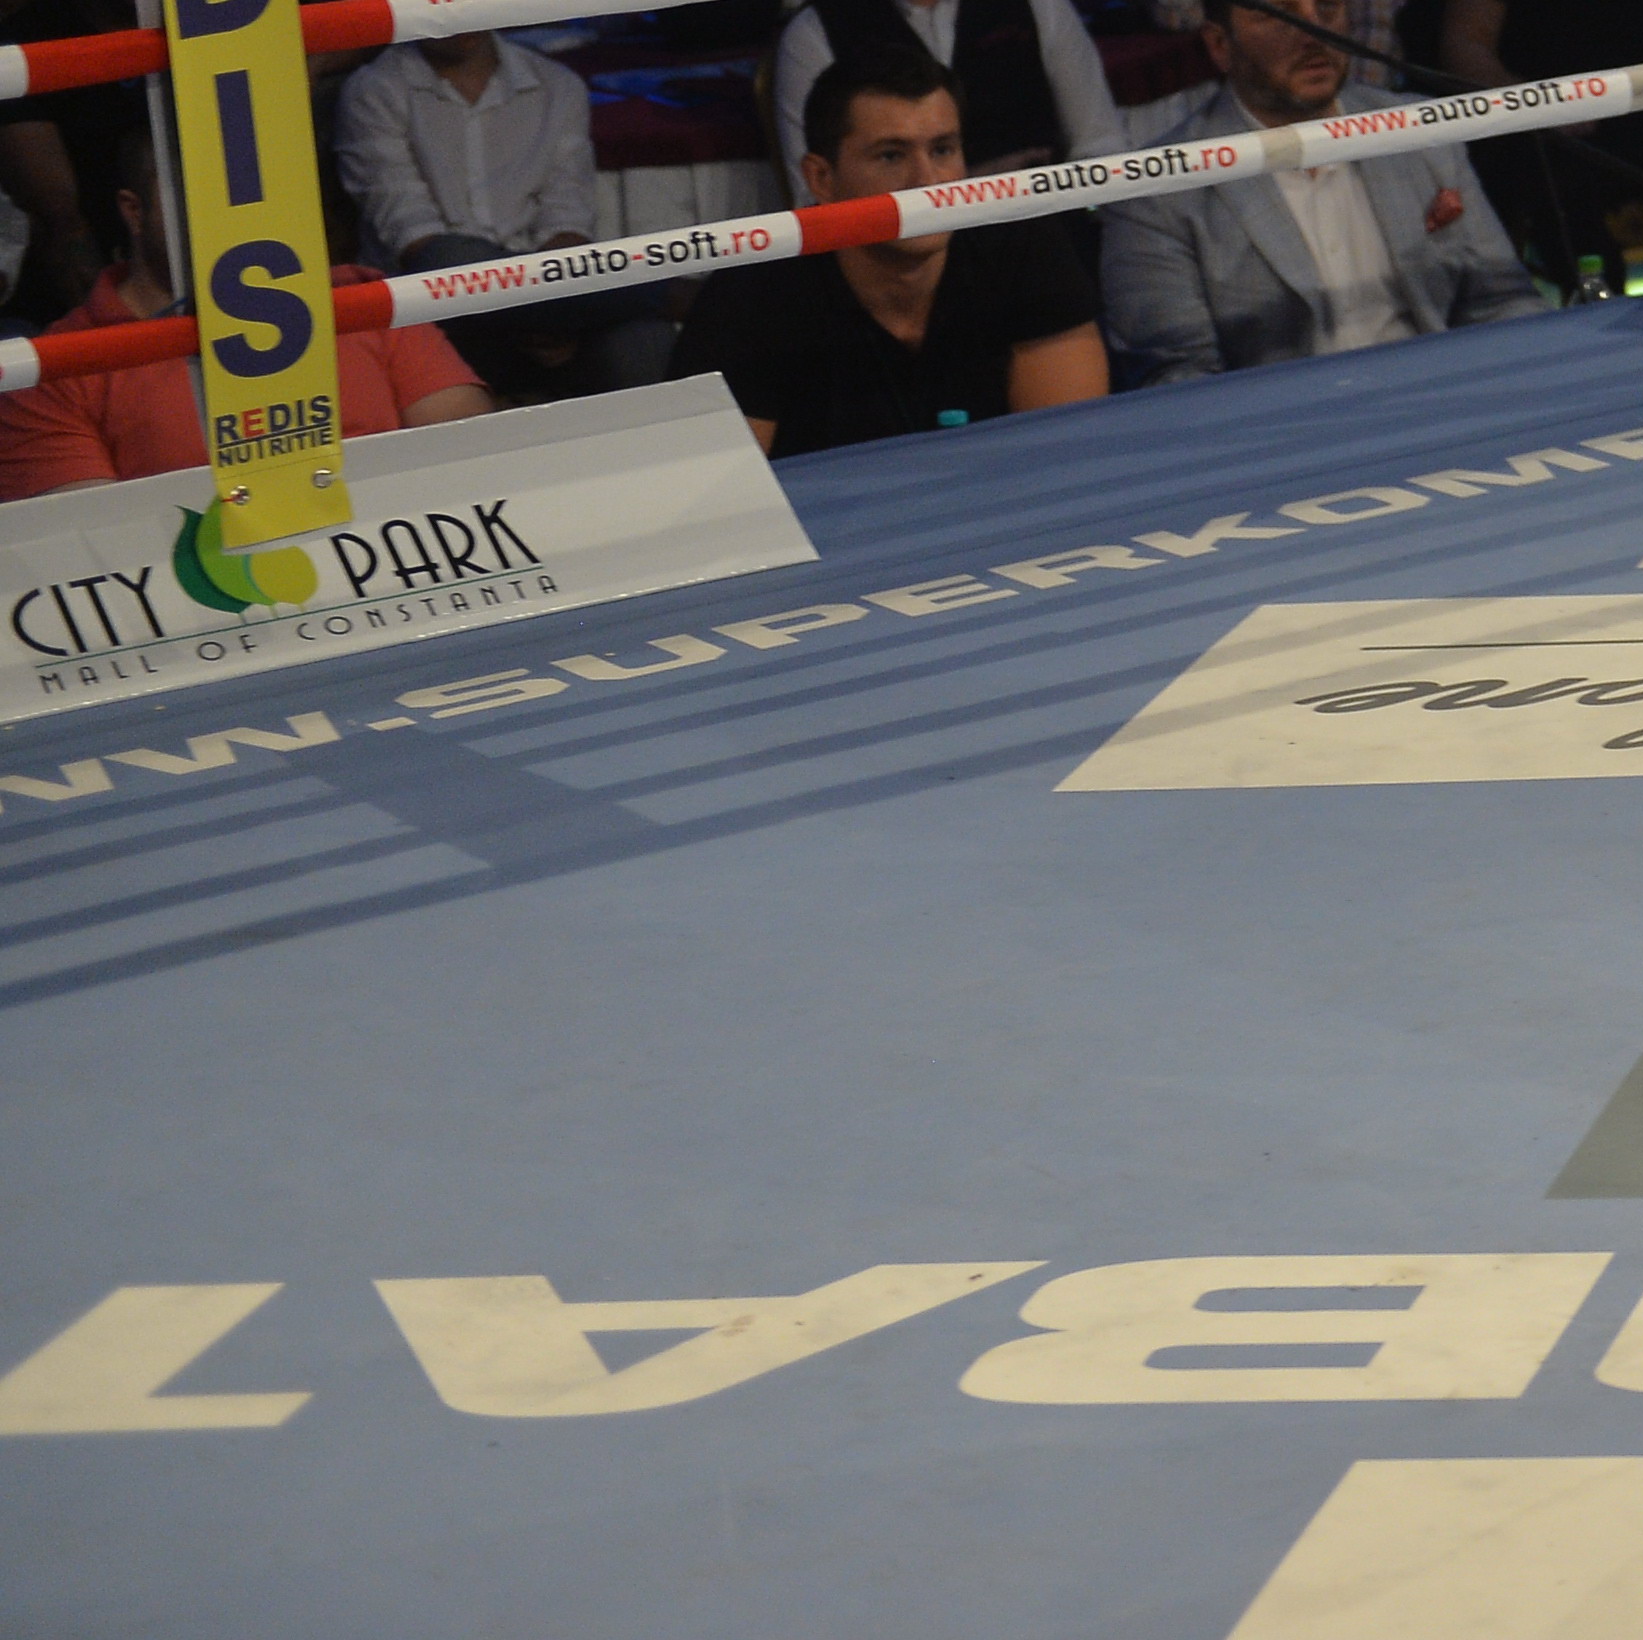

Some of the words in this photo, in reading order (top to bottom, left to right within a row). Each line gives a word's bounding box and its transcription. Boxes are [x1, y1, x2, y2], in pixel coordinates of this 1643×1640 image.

[1323, 77, 1609, 140] www.auto-soft.ro
[924, 145, 1239, 210] www.auto-soft.ro
[423, 228, 772, 301] www.auto-soft.ro
[215, 394, 333, 444] REDIS
[217, 425, 334, 468] NUTRITIE
[13, 566, 166, 658] CITY
[331, 498, 542, 599] PARK
[40, 656, 159, 695] MALL
[198, 633, 262, 664] OF
[297, 573, 561, 644] CONSTANTA
